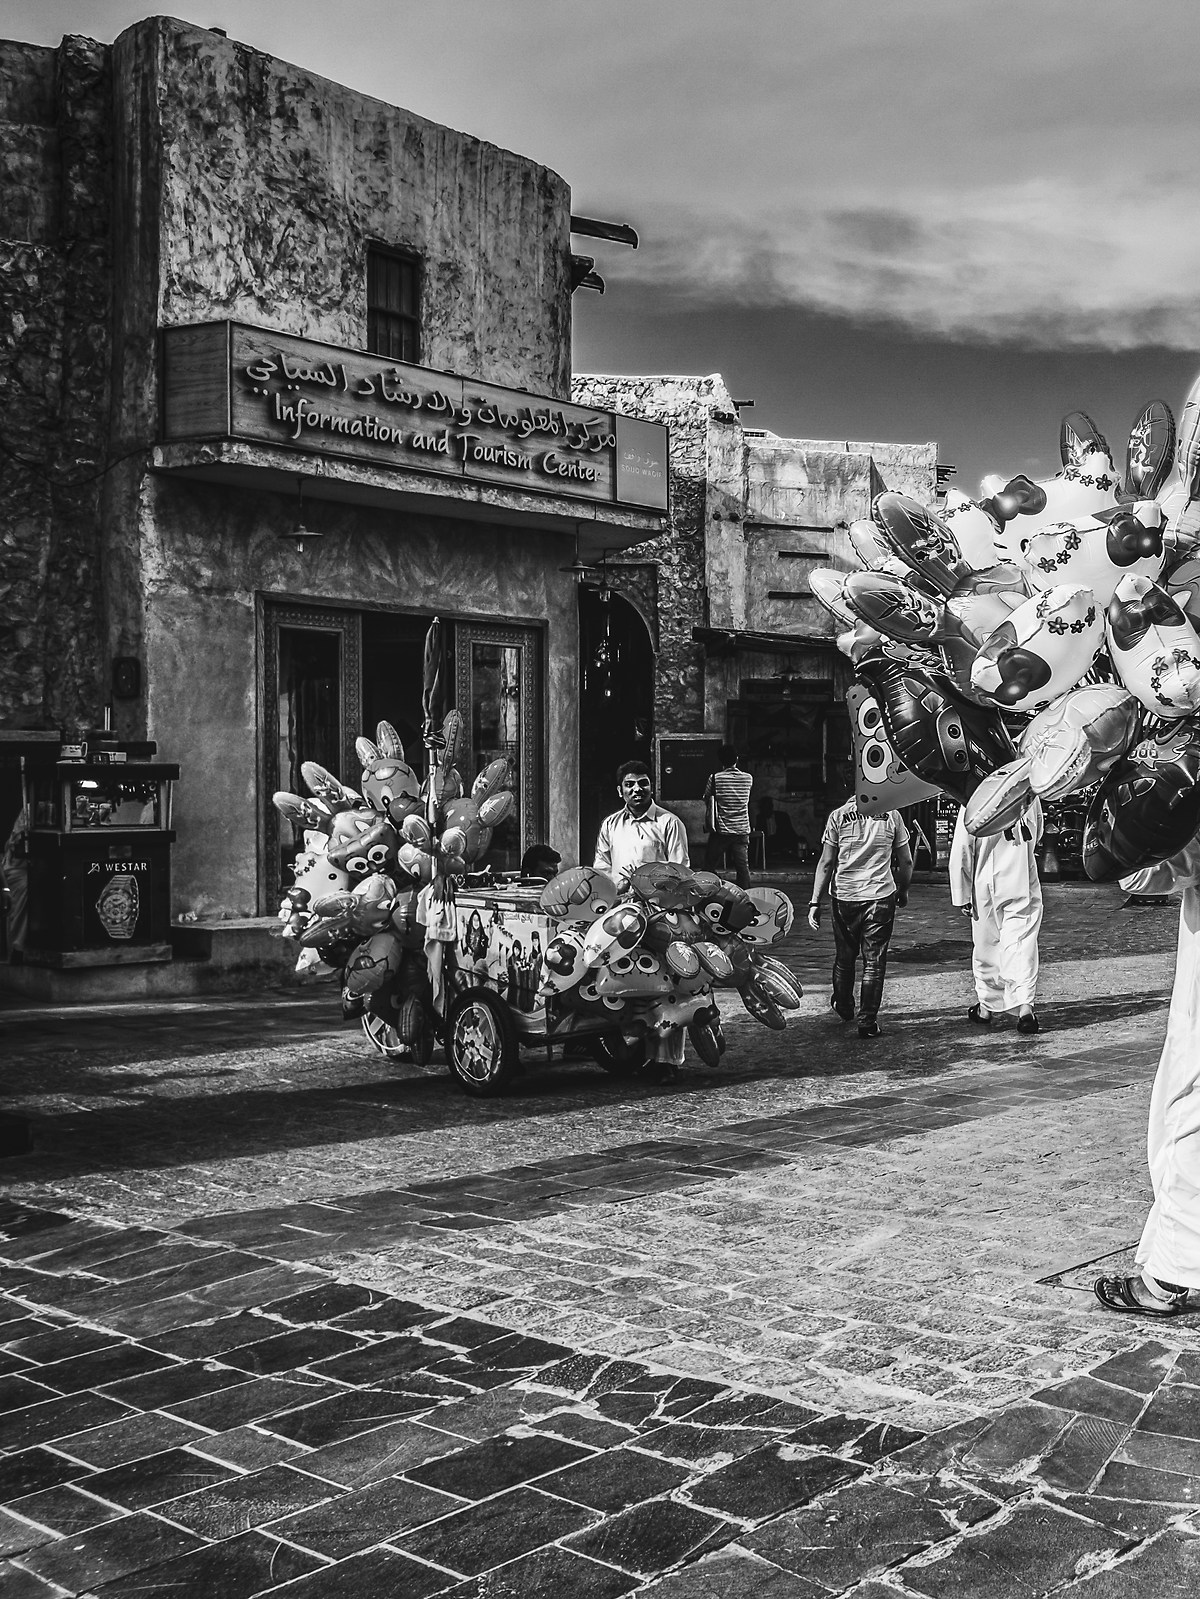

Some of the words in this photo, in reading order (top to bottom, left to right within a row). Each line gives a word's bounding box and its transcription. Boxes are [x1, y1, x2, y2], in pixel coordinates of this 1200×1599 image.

[246, 353, 348, 396] السياحي
[275, 392, 403, 444] Information
[412, 429, 449, 454] and
[456, 433, 532, 470] Tourism
[543, 451, 601, 482] Center
[477, 399, 569, 438] المعلومات
[569, 417, 616, 452] مركز
[642, 469, 662, 478] WAQIF
[105, 862, 147, 872] WESTAR
